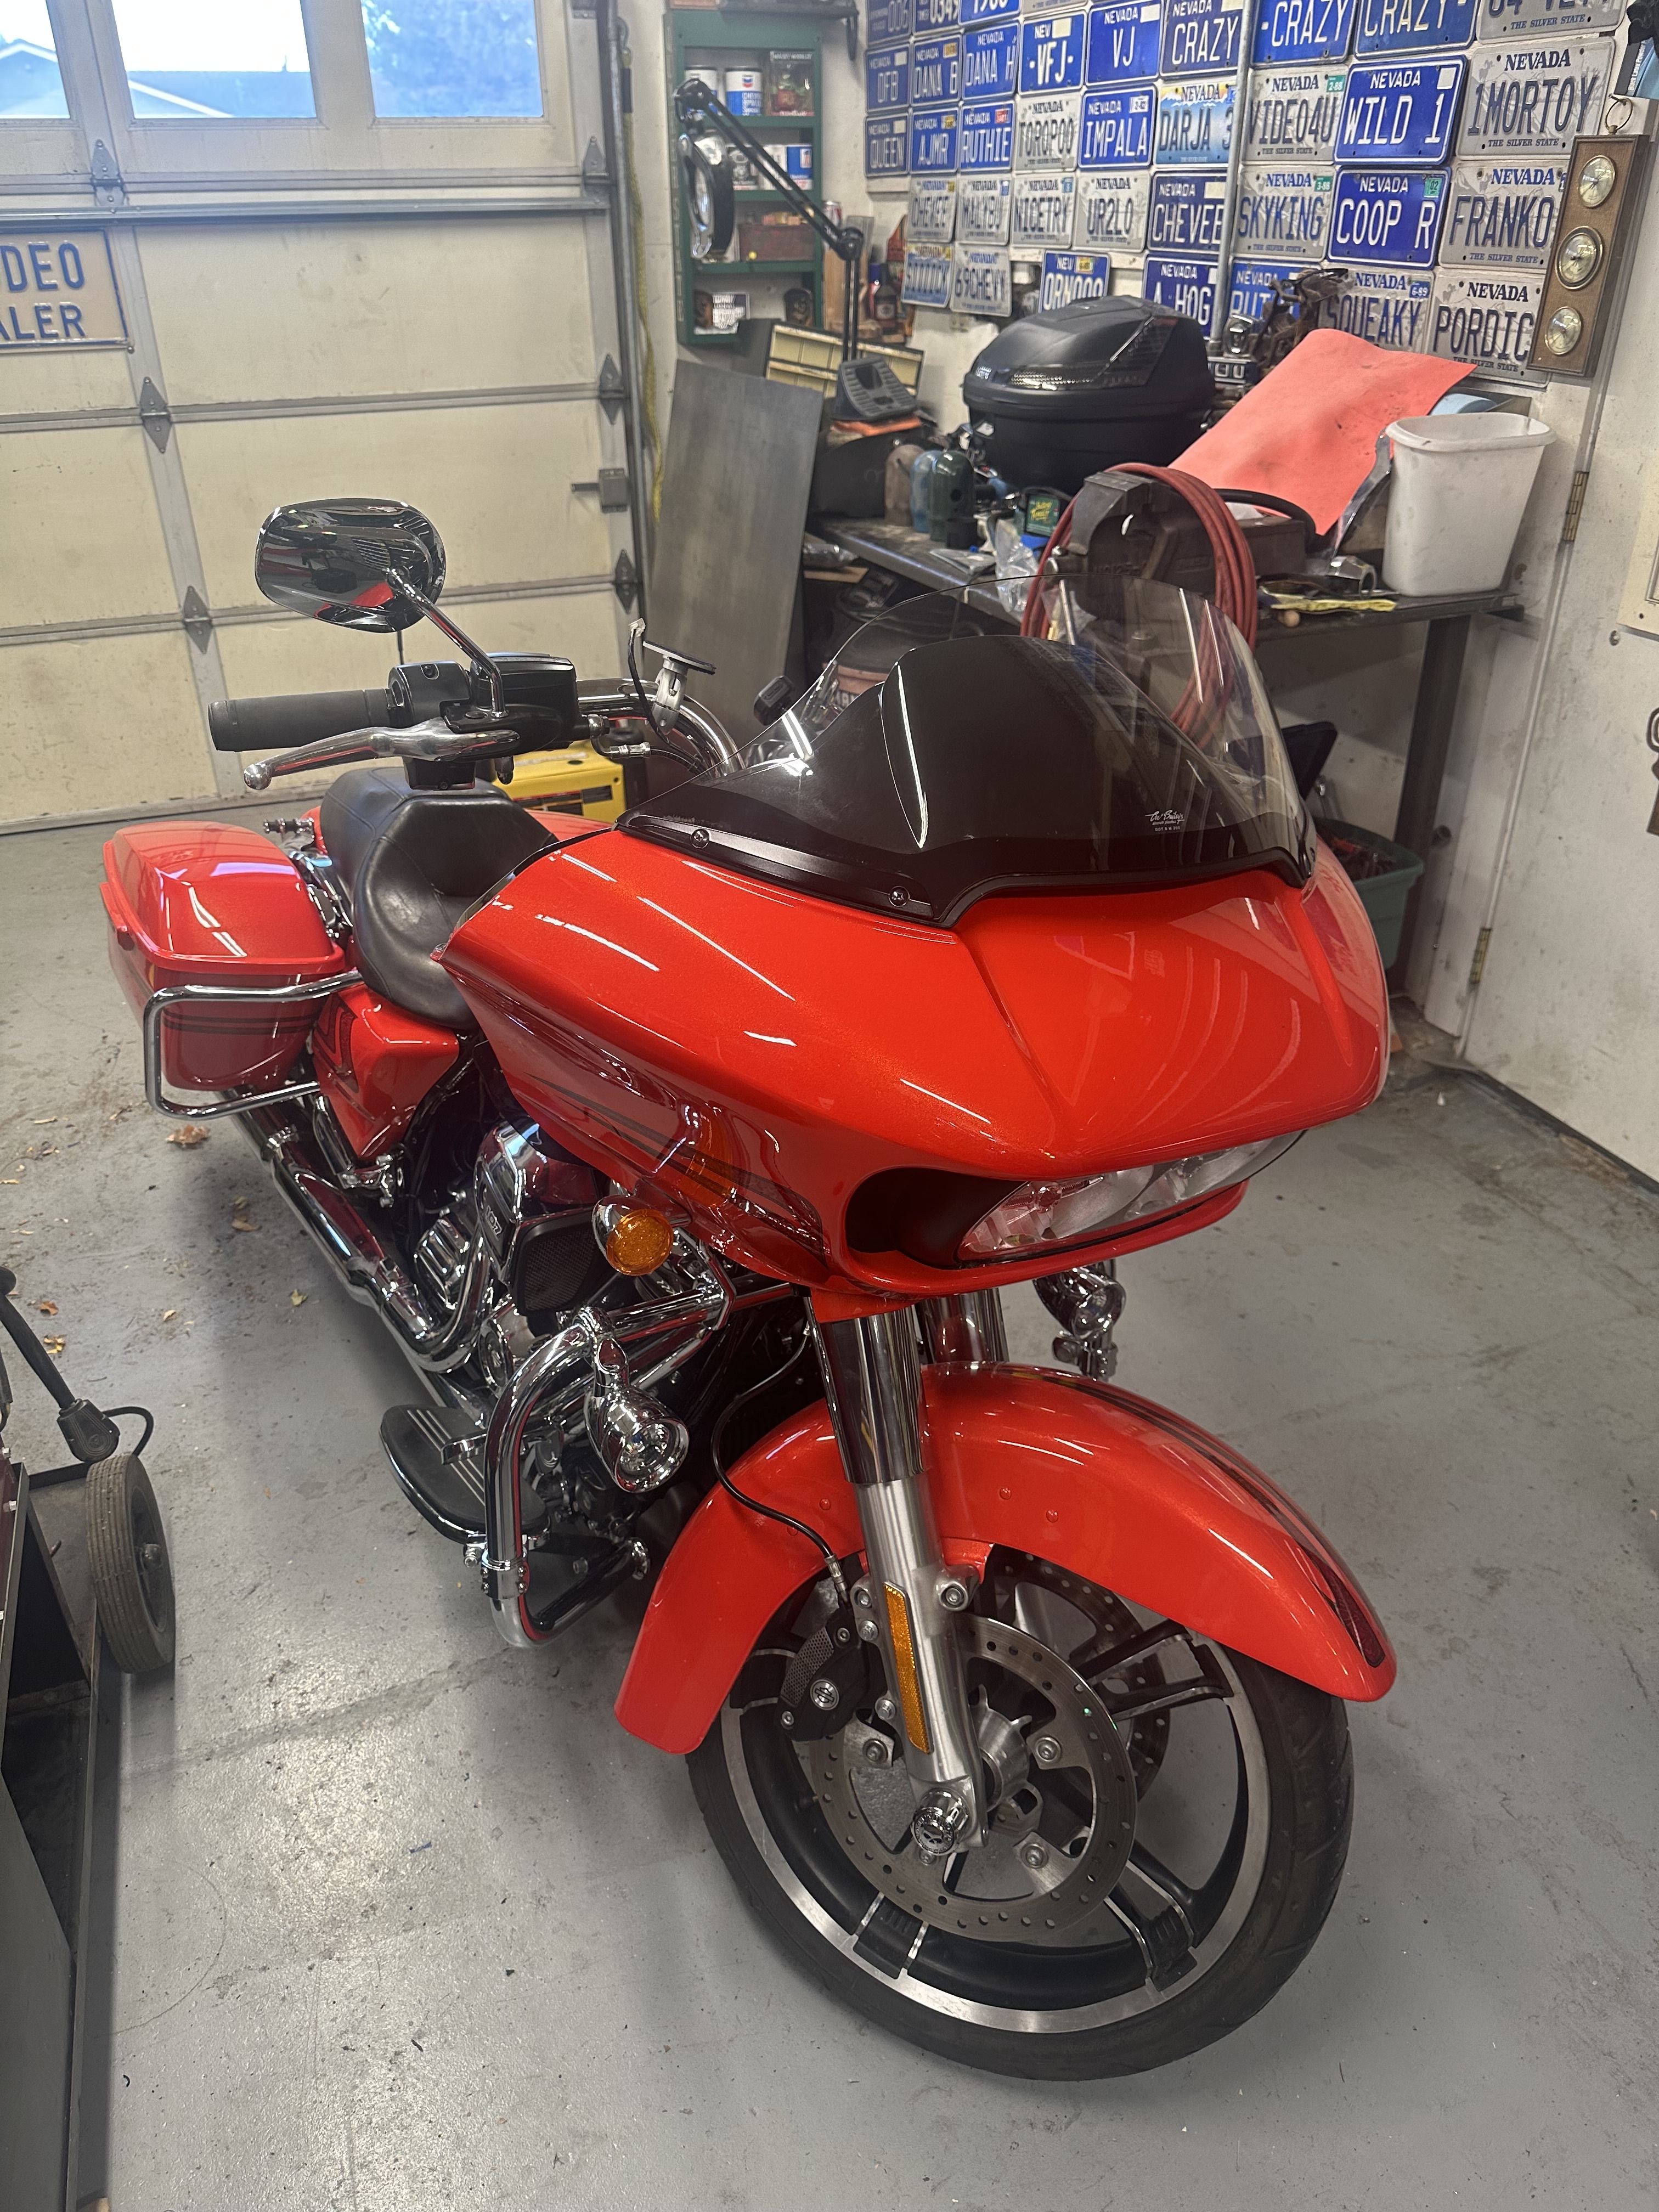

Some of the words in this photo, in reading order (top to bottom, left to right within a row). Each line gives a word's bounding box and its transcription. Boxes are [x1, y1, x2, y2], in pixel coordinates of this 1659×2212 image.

[1104, 7, 1138, 24] NEVADA
[1172, 0, 1212, 16] NEVADA
[1510, 21, 1527, 30] THE
[1530, 18, 1558, 27] SILVER
[1560, 14, 1585, 25] STATE
[977, 31, 1005, 46] NEVADA
[1113, 26, 1136, 67] VJ
[1172, 15, 1239, 65] CRAZY
[964, 49, 998, 86] DANA
[1005, 46, 1015, 80] H
[1504, 49, 1571, 71] NEVADA
[914, 64, 943, 98] DANA
[1272, 75, 1319, 92] NEVADA
[1370, 70, 1421, 89] NEVADA
[1181, 83, 1220, 102] NEVADA
[1032, 100, 1063, 114] NEVADA
[1088, 100, 1122, 115] NEVADA
[1468, 74, 1598, 136] 1MORTOY
[964, 112, 991, 125] NEVADA
[1344, 94, 1413, 145] WILD
[1425, 93, 1445, 144] 1
[1084, 117, 1147, 158] IMPALA
[1159, 108, 1211, 151] DARJA
[960, 127, 1012, 163] RUTHIE
[1488, 139, 1504, 148] THE
[1506, 138, 1532, 147] SILVER
[1536, 138, 1559, 147] STATE
[1028, 179, 1059, 191] NEVADA
[1096, 177, 1132, 190] NEVADA
[1266, 173, 1312, 188] NEVADA
[1359, 177, 1409, 193] NEVADA
[1491, 168, 1555, 185] NEVADA
[1159, 183, 1196, 196] NEVADA
[1238, 196, 1324, 241] SKYKING
[1336, 198, 1402, 246] COOP
[1414, 200, 1436, 249] R
[1449, 195, 1555, 249] FRANKO
[1487, 253, 1513, 262] SILVER
[1516, 255, 1539, 264] STATE
[1161, 264, 1198, 279] NEVADA
[1355, 272, 1407, 290] NEVADA
[1467, 283, 1528, 302] NEVADA
[1174, 284, 1212, 325] HOG
[1327, 294, 1421, 347] SQUEAKY
[1433, 306, 1534, 362] PORDIC
[1497, 363, 1519, 372] STATE
